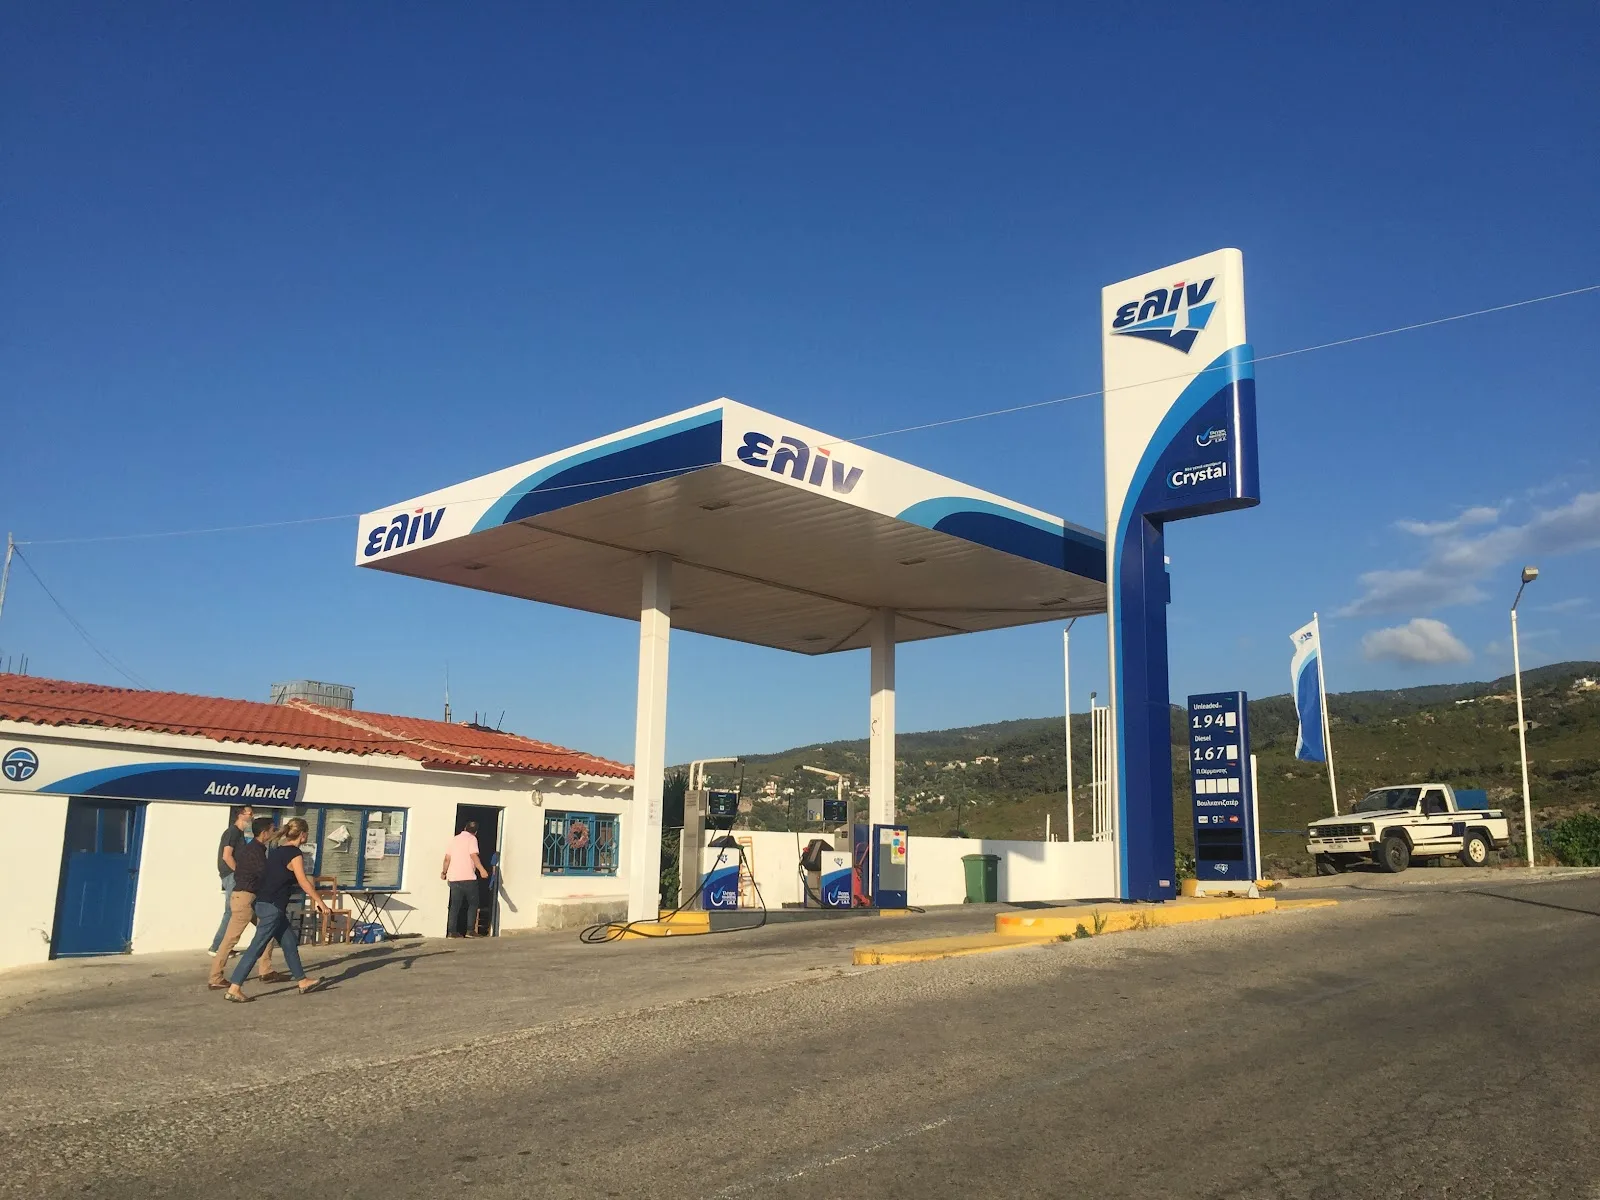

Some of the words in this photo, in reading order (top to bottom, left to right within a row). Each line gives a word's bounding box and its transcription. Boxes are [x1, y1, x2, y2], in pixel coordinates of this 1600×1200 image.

[1171, 461, 1227, 486] Crystal
[1193, 702, 1219, 710] Unleaded
[1192, 713, 1225, 729] 1.94
[1194, 734, 1212, 742] Diesel
[1194, 746, 1225, 760] 1.67
[204, 781, 240, 797] Auto
[241, 783, 292, 800] Market
